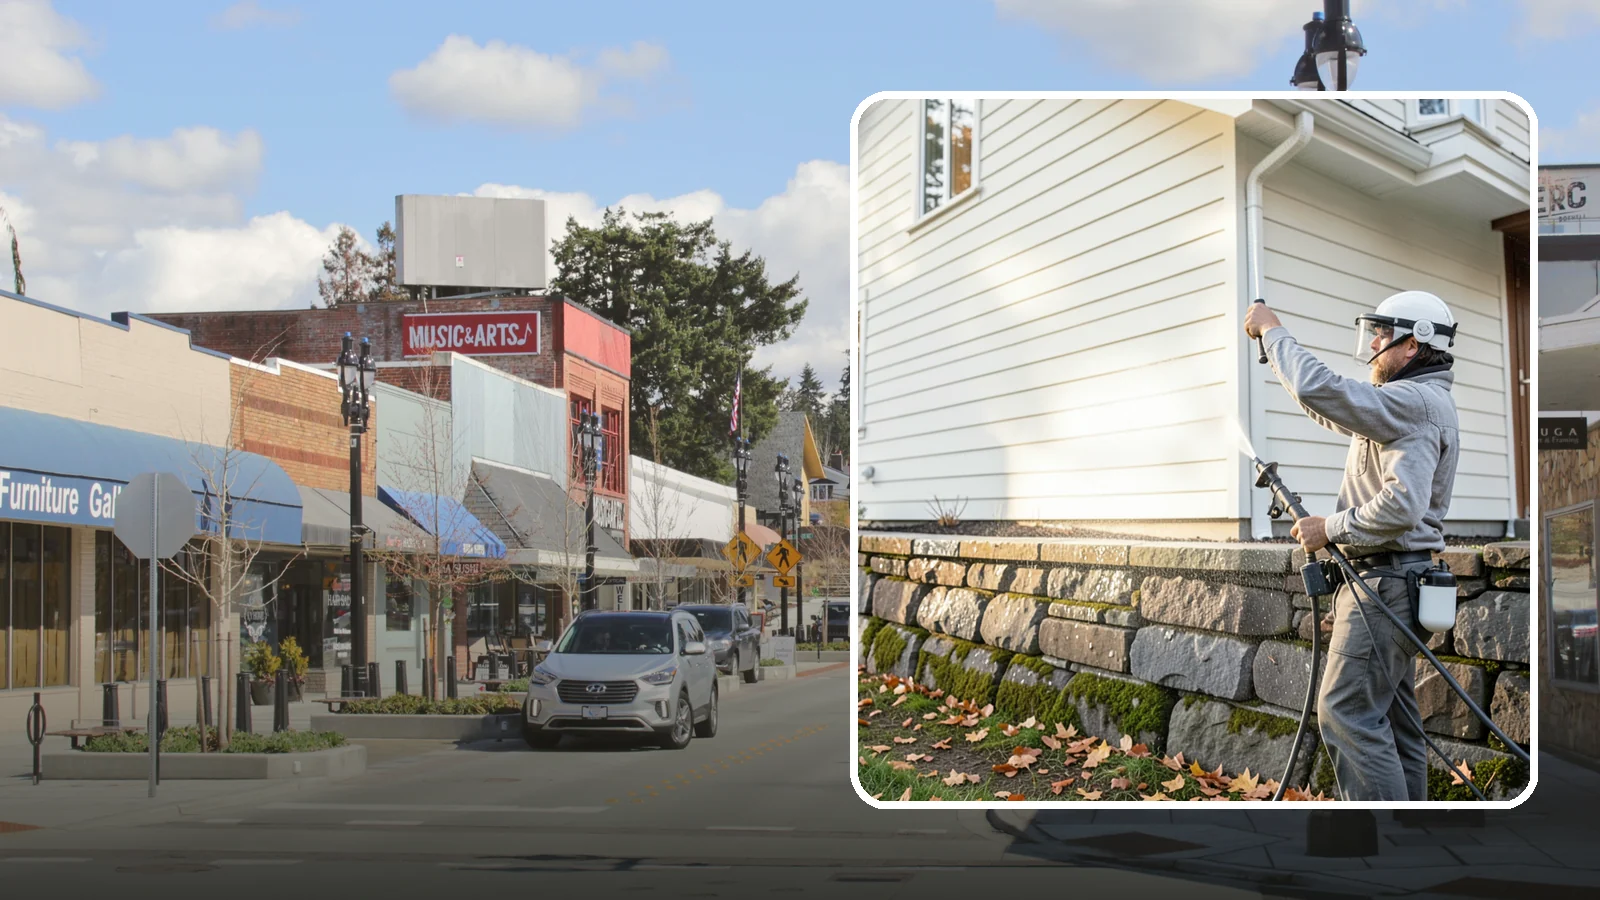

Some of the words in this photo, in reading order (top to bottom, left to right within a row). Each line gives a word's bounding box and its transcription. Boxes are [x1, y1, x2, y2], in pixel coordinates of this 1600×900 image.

[1540, 428, 1577, 436] UGA
[1552, 436, 1578, 444] Framing
[0, 472, 79, 515] Furniture
[454, 563, 479, 573] SUSHI
